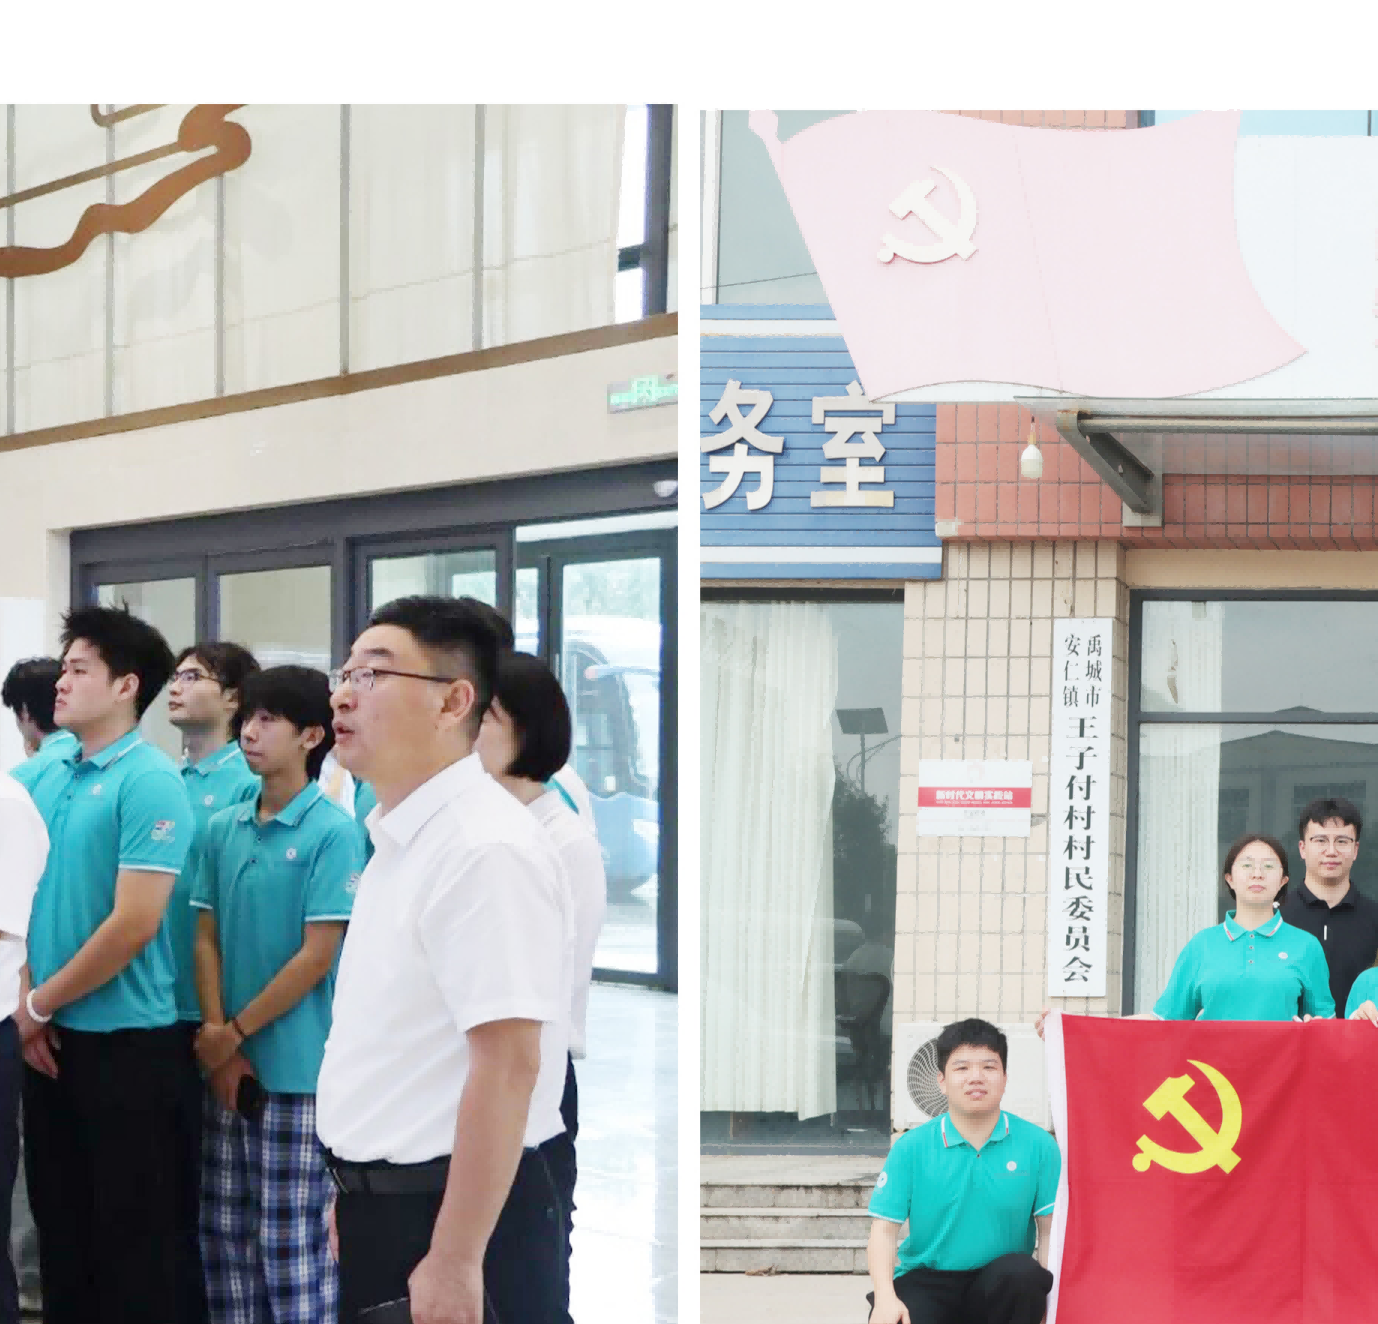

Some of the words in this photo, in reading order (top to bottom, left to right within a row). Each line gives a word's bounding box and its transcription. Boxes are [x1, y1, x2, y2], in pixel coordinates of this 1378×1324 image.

[700, 378, 895, 511] 务室
[1063, 633, 1081, 708] 安仁镇
[1085, 634, 1103, 709] 禹城市
[1062, 715, 1099, 982] 王子付村村民委员会
